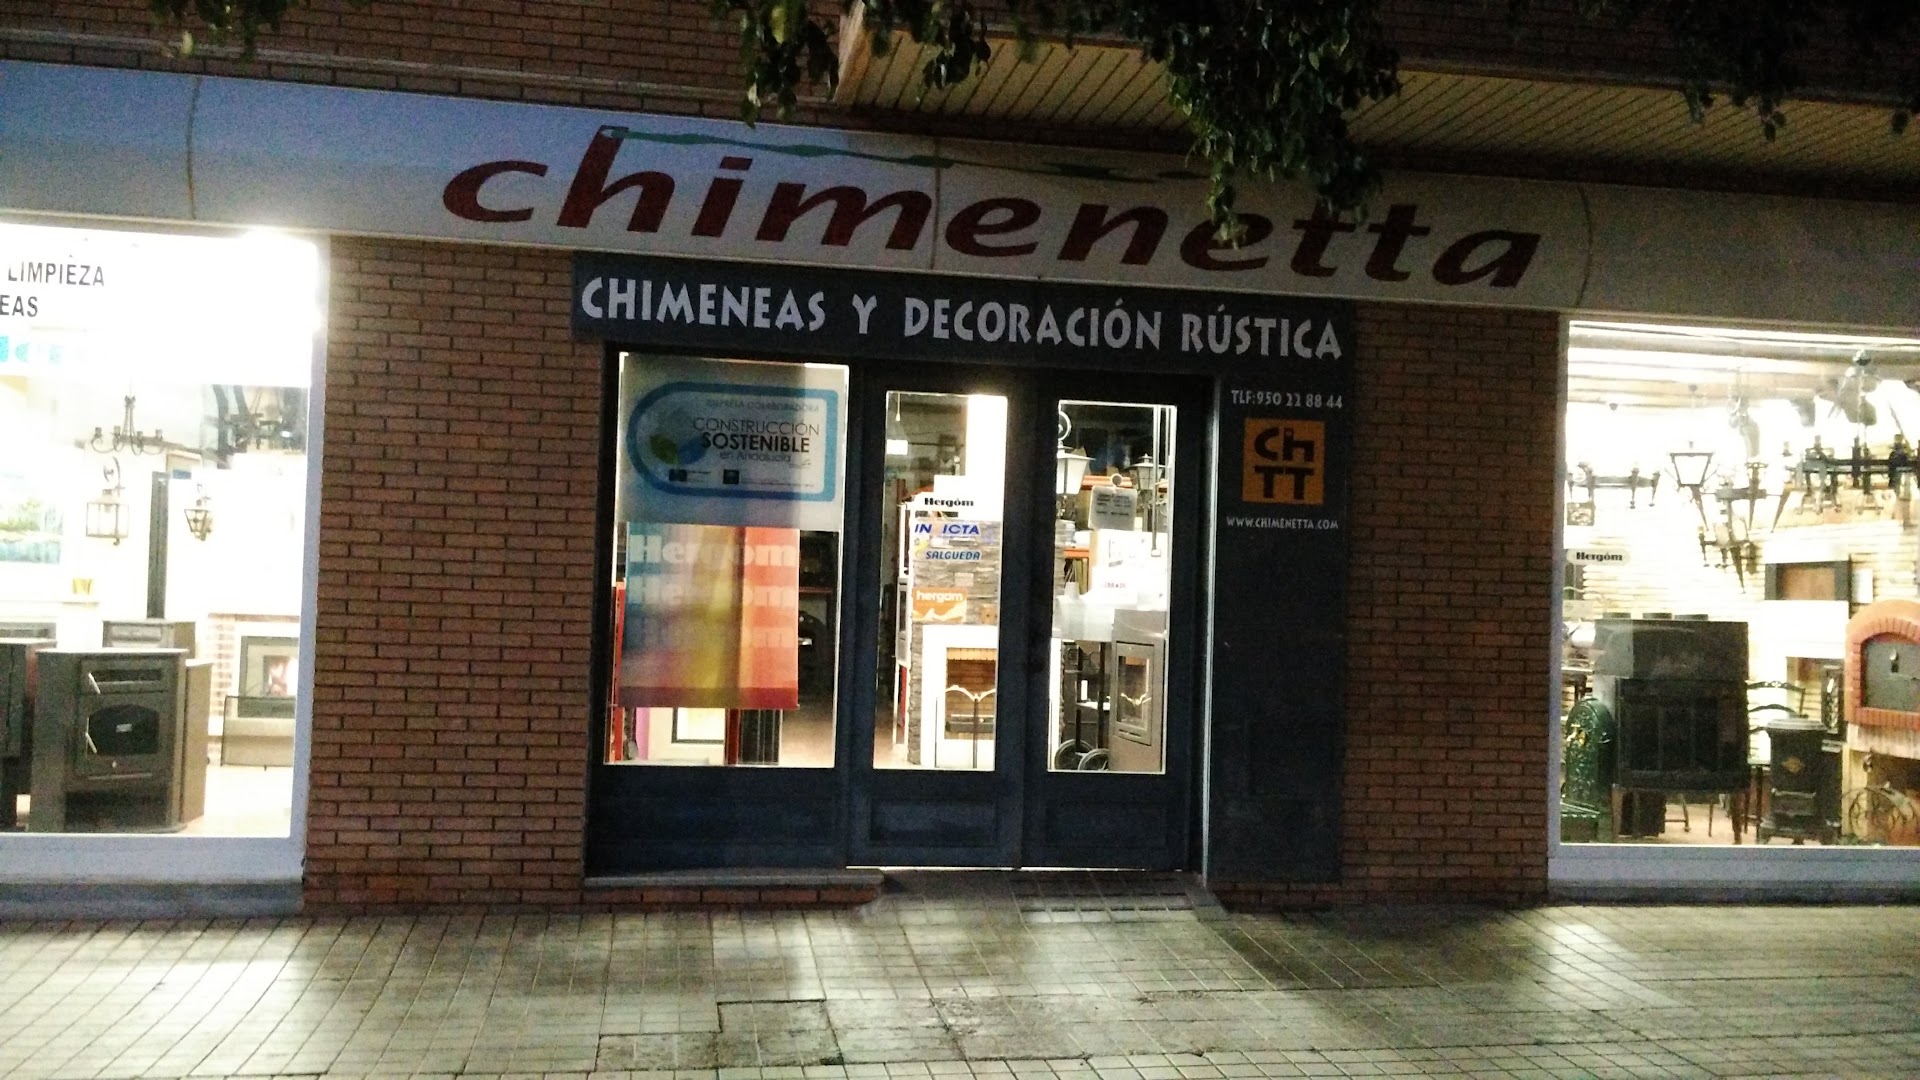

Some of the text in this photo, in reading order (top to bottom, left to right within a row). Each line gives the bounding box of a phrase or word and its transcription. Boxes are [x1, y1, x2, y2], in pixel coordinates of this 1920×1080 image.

[442, 125, 1541, 288] chimenetta
[8, 261, 104, 286] LIMPIEZA
[581, 276, 1343, 361] CHIMENEAS Y DECORACIÓN RÚSTICA
[1286, 392, 1301, 407] 22
[1306, 394, 1322, 408] 88
[1326, 395, 1343, 409] 44
[692, 416, 820, 436] CONSTRUCCIÓN
[702, 431, 810, 453] SOSTENIBLE
[1226, 515, 1339, 530] WWW.CHIMENETTA.COM
[925, 550, 981, 560] SALGUEDA
